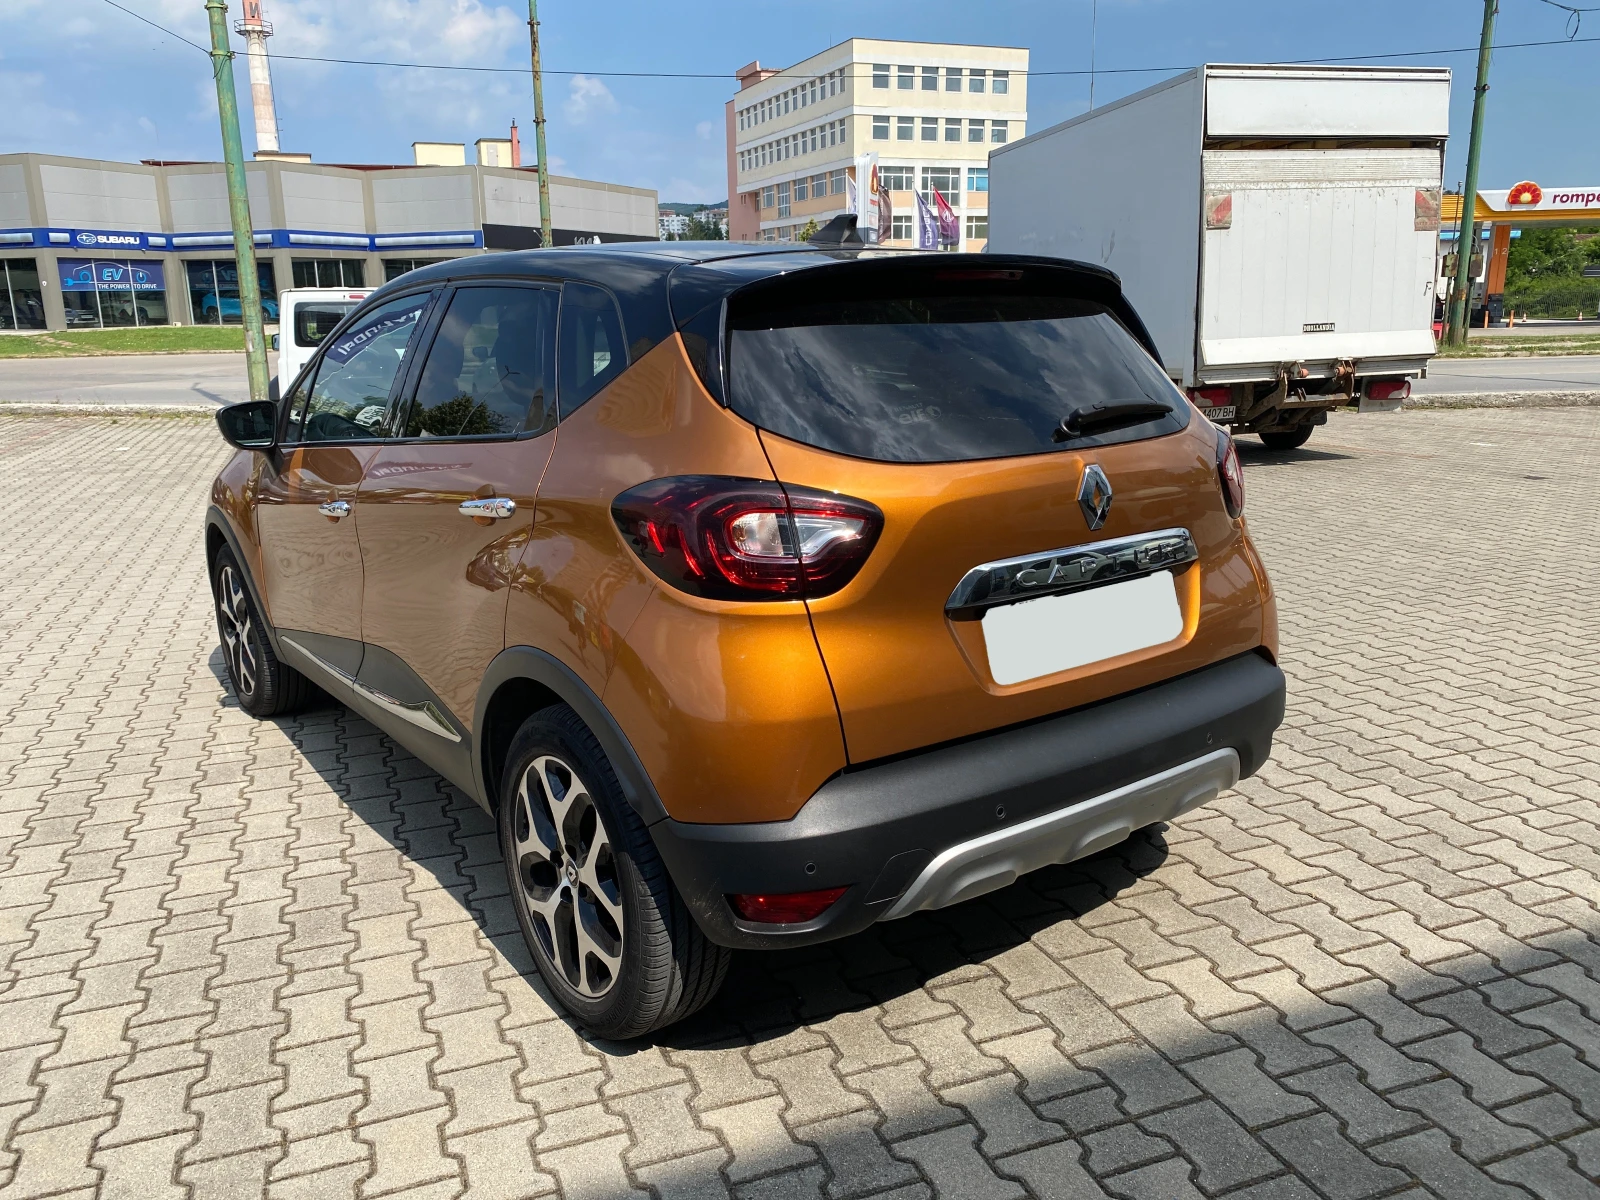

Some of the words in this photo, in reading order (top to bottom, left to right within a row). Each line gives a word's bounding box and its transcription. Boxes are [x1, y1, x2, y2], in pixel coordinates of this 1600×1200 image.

[97, 235, 140, 245] SUBARU
[1501, 247, 1508, 255] 2
[102, 268, 123, 281] EV
[1223, 406, 1235, 418] BH
[1016, 543, 1176, 588] CAPTUR
